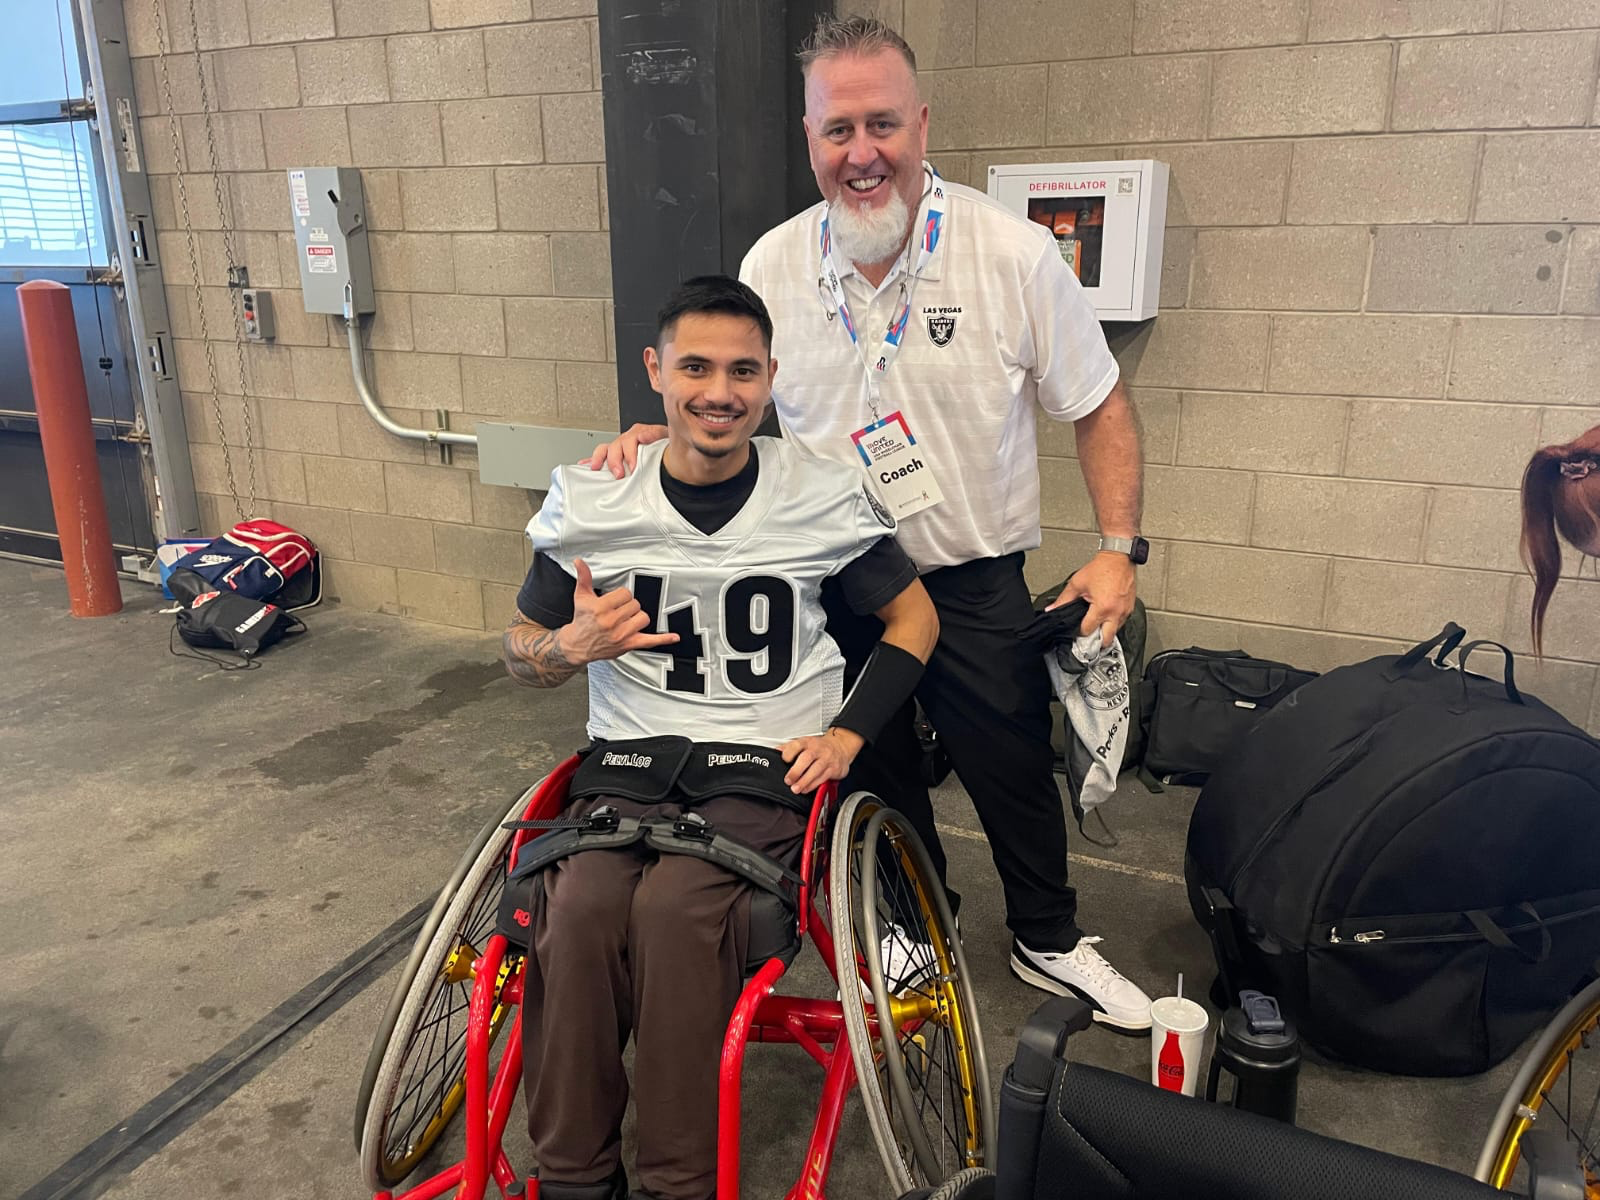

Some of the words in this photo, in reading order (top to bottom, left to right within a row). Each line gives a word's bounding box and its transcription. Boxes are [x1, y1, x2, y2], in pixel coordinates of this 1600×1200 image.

[1029, 181, 1106, 191] DEFIBRILLATOR
[880, 458, 924, 484] Coach
[627, 569, 800, 699] 49
[1106, 686, 1128, 708] NEVAD
[1096, 723, 1118, 759] Parks
